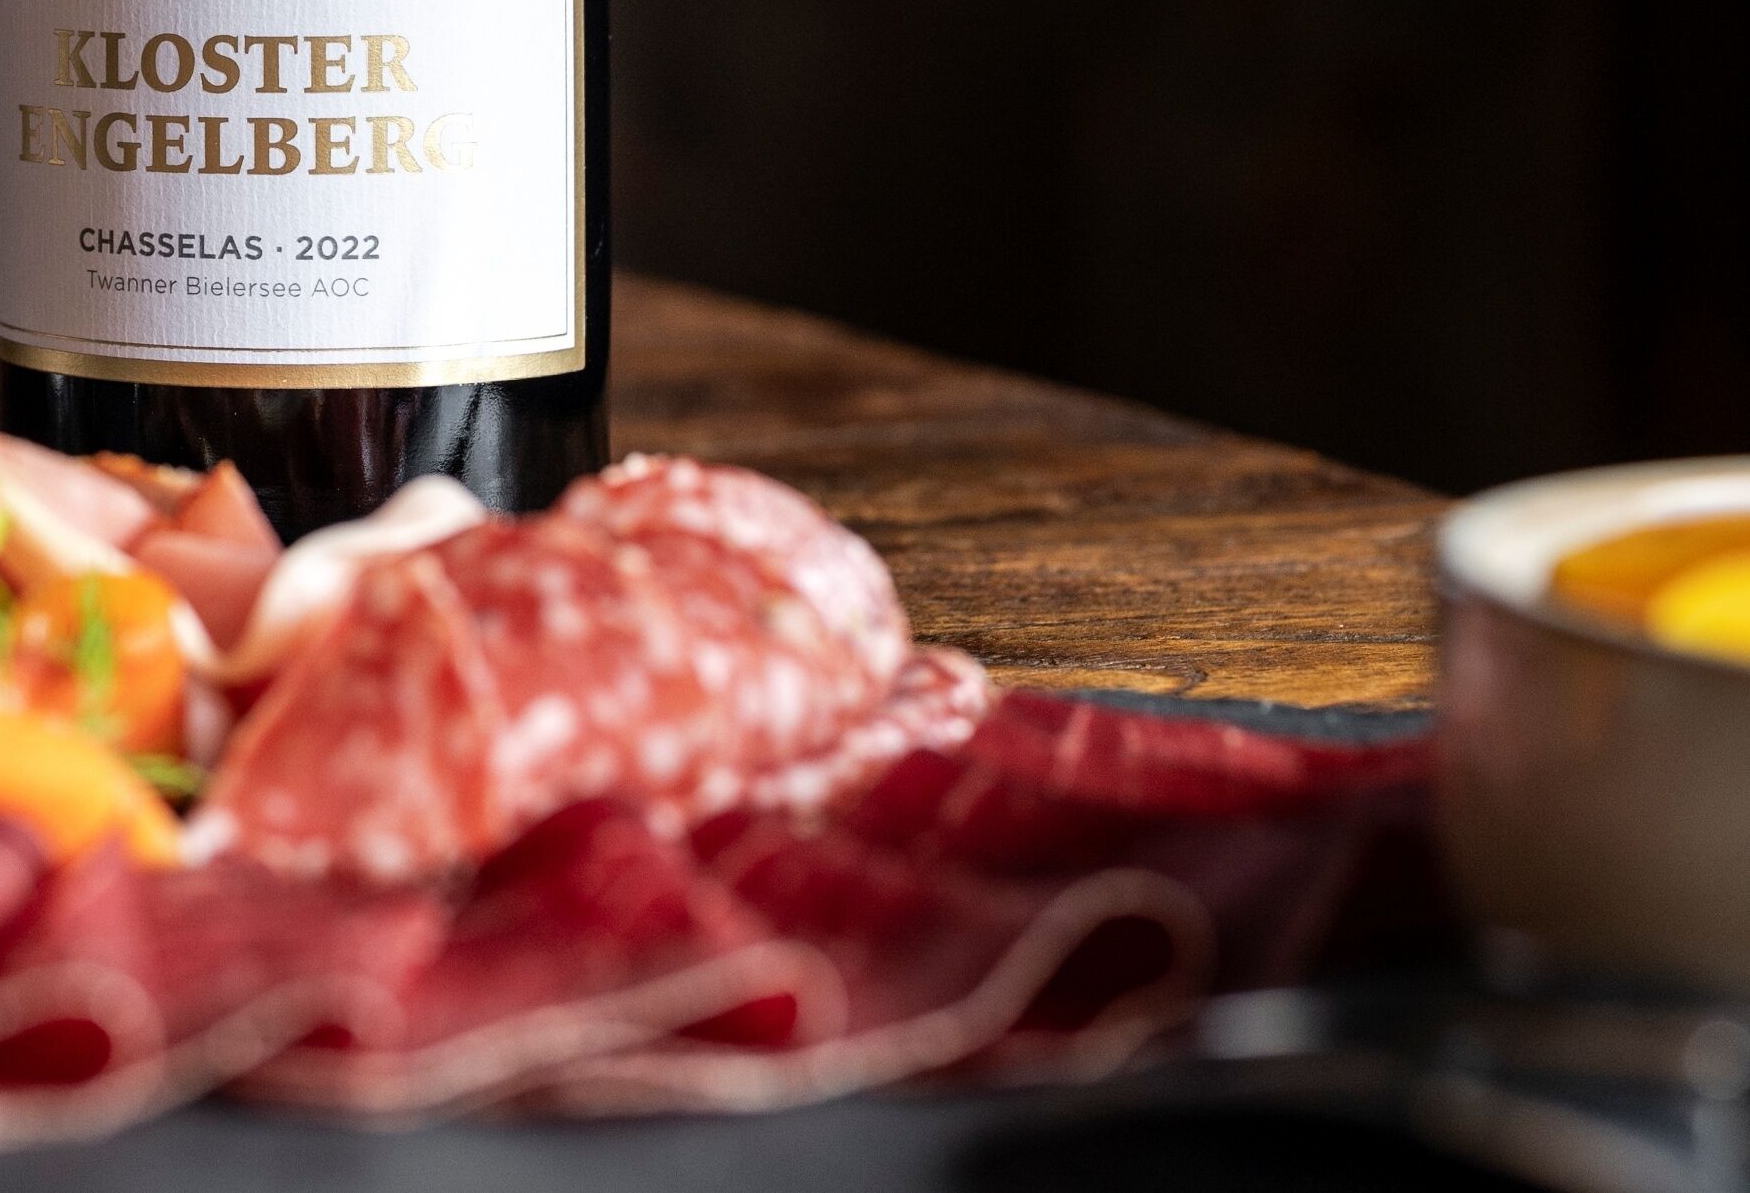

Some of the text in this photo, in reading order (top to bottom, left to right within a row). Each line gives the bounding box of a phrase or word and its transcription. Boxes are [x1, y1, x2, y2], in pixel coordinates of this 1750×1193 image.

[53, 29, 419, 94] KLOSTER
[18, 104, 478, 176] ENGELBERG
[79, 228, 263, 260] CHASSELAS
[295, 235, 380, 260] 2022
[87, 270, 370, 298] Twanner Bielersee AOC
